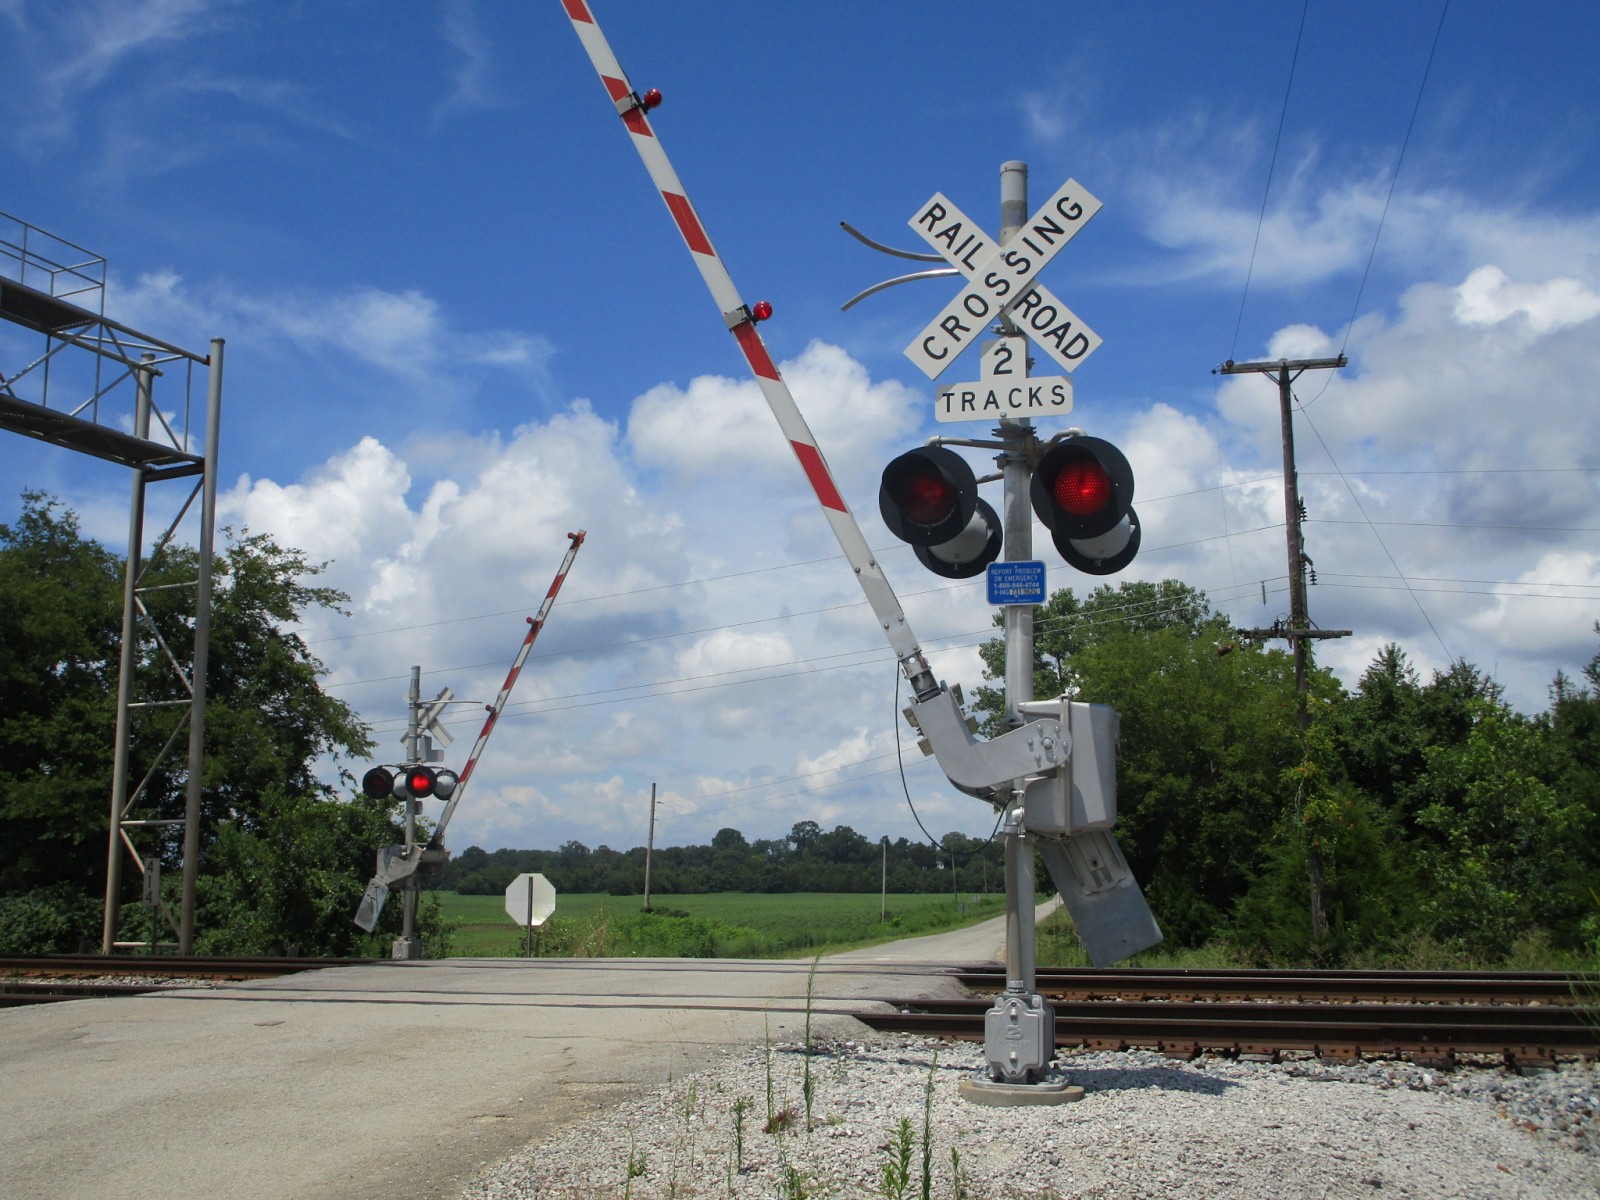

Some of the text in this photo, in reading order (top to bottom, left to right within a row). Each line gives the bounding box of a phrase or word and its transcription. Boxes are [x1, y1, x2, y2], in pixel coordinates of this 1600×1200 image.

[918, 202, 984, 272] RAIL
[922, 196, 1083, 361] CROSSING
[1012, 288, 1089, 361] ROAD
[993, 347, 1013, 376] 2
[942, 385, 1065, 413] TRACKS
[1015, 567, 1041, 575] PROBLEM
